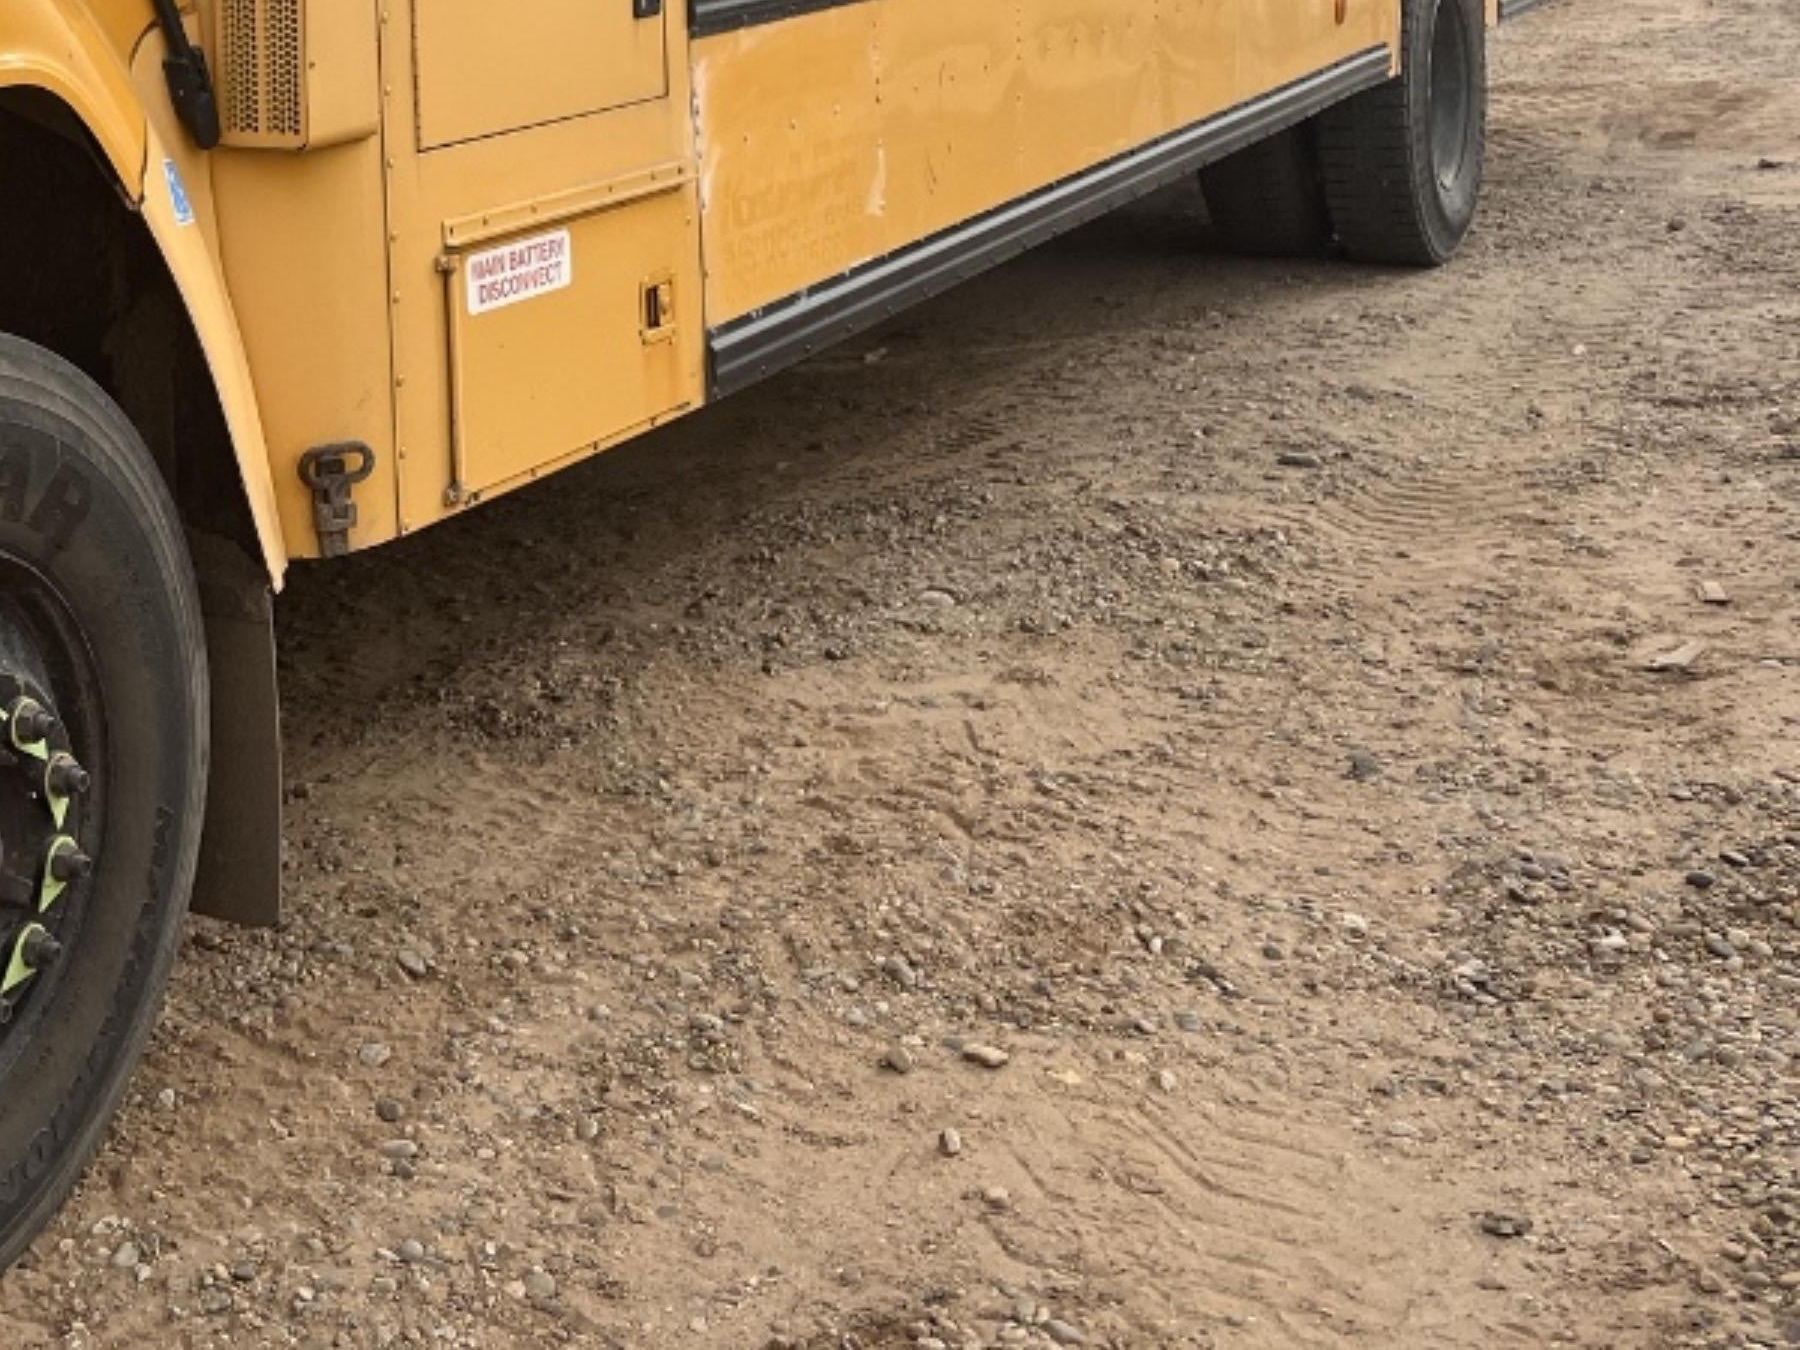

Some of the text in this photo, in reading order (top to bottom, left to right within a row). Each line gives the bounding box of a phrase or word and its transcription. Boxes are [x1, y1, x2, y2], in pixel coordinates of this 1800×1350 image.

[471, 235, 566, 282] MAIN BATTERY
[478, 261, 564, 305] DISCONNECT
